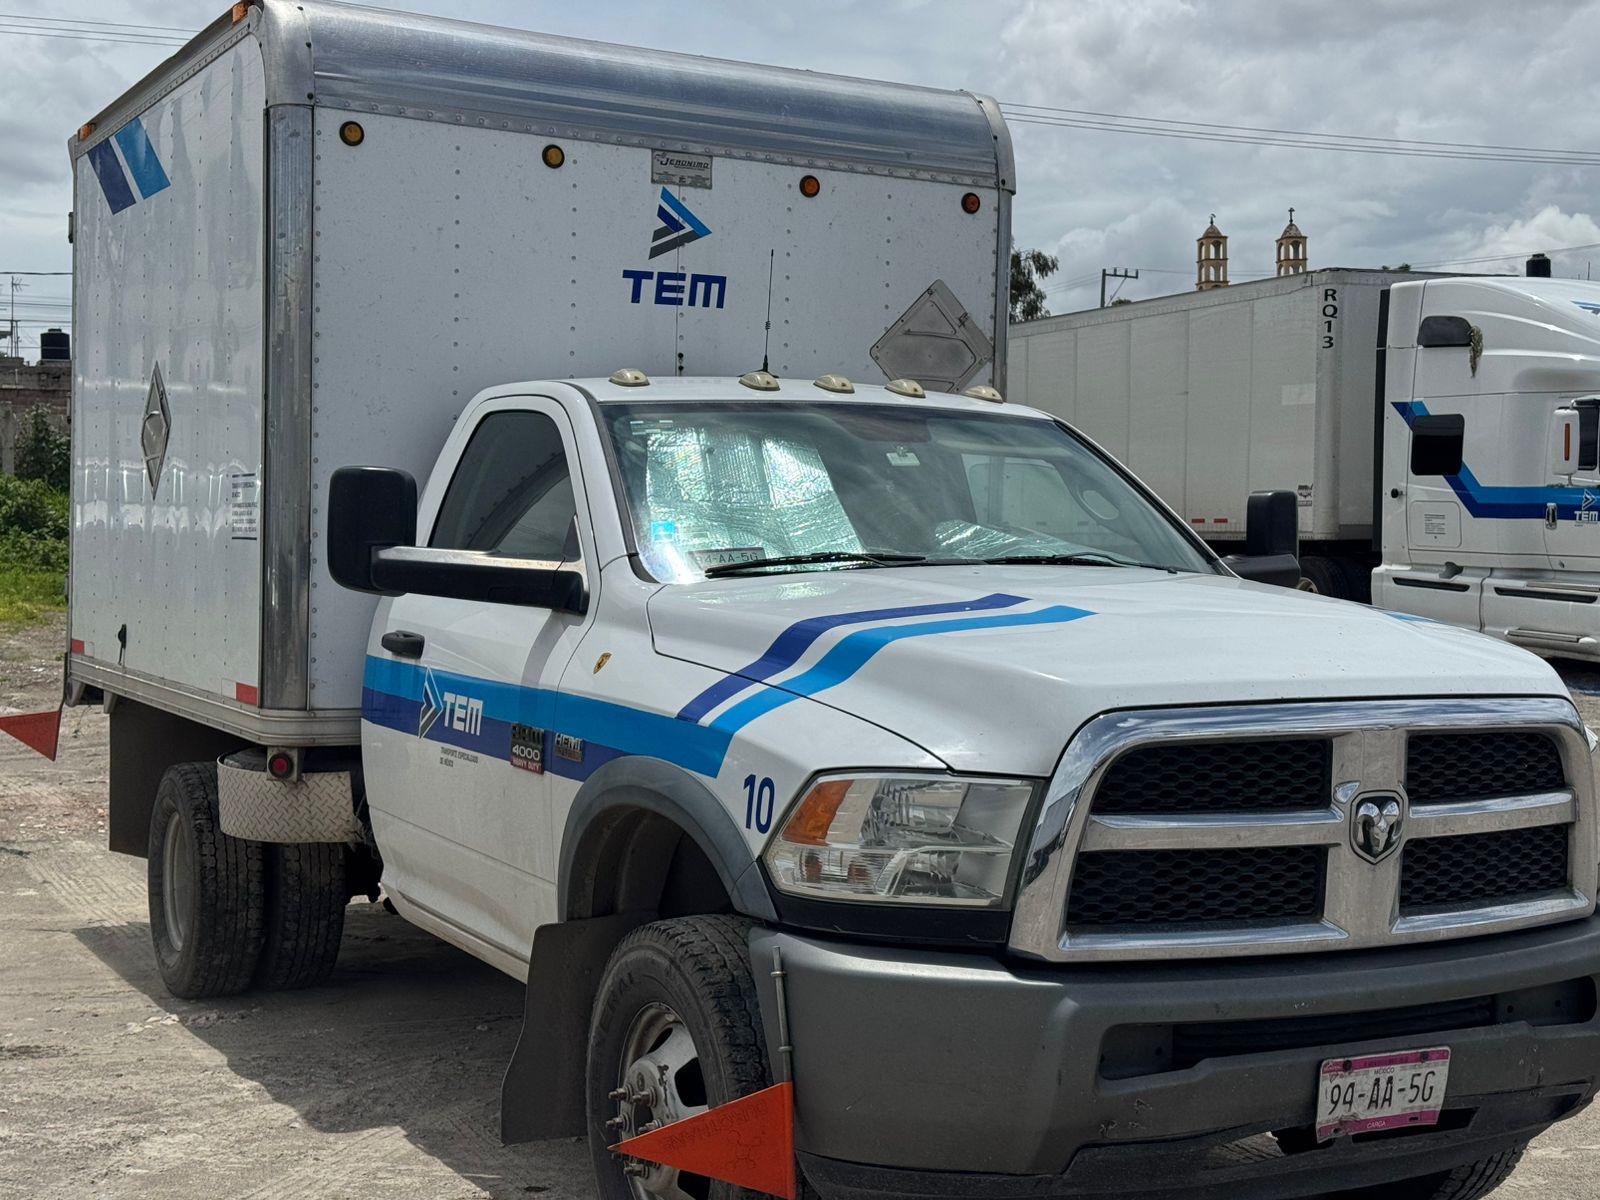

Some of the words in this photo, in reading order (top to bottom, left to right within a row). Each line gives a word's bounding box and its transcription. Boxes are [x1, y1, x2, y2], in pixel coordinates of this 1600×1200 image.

[622, 269, 727, 308] TEM
[1322, 288, 1337, 349] RQ13
[1574, 511, 1598, 521] TEM
[443, 691, 483, 736] TEM
[513, 745, 540, 760] 4000
[555, 732, 582, 751] HEMI
[743, 773, 775, 834] 10
[1328, 1070, 1436, 1115] 94-AA-5G
[1367, 1120, 1386, 1129] CARGA
